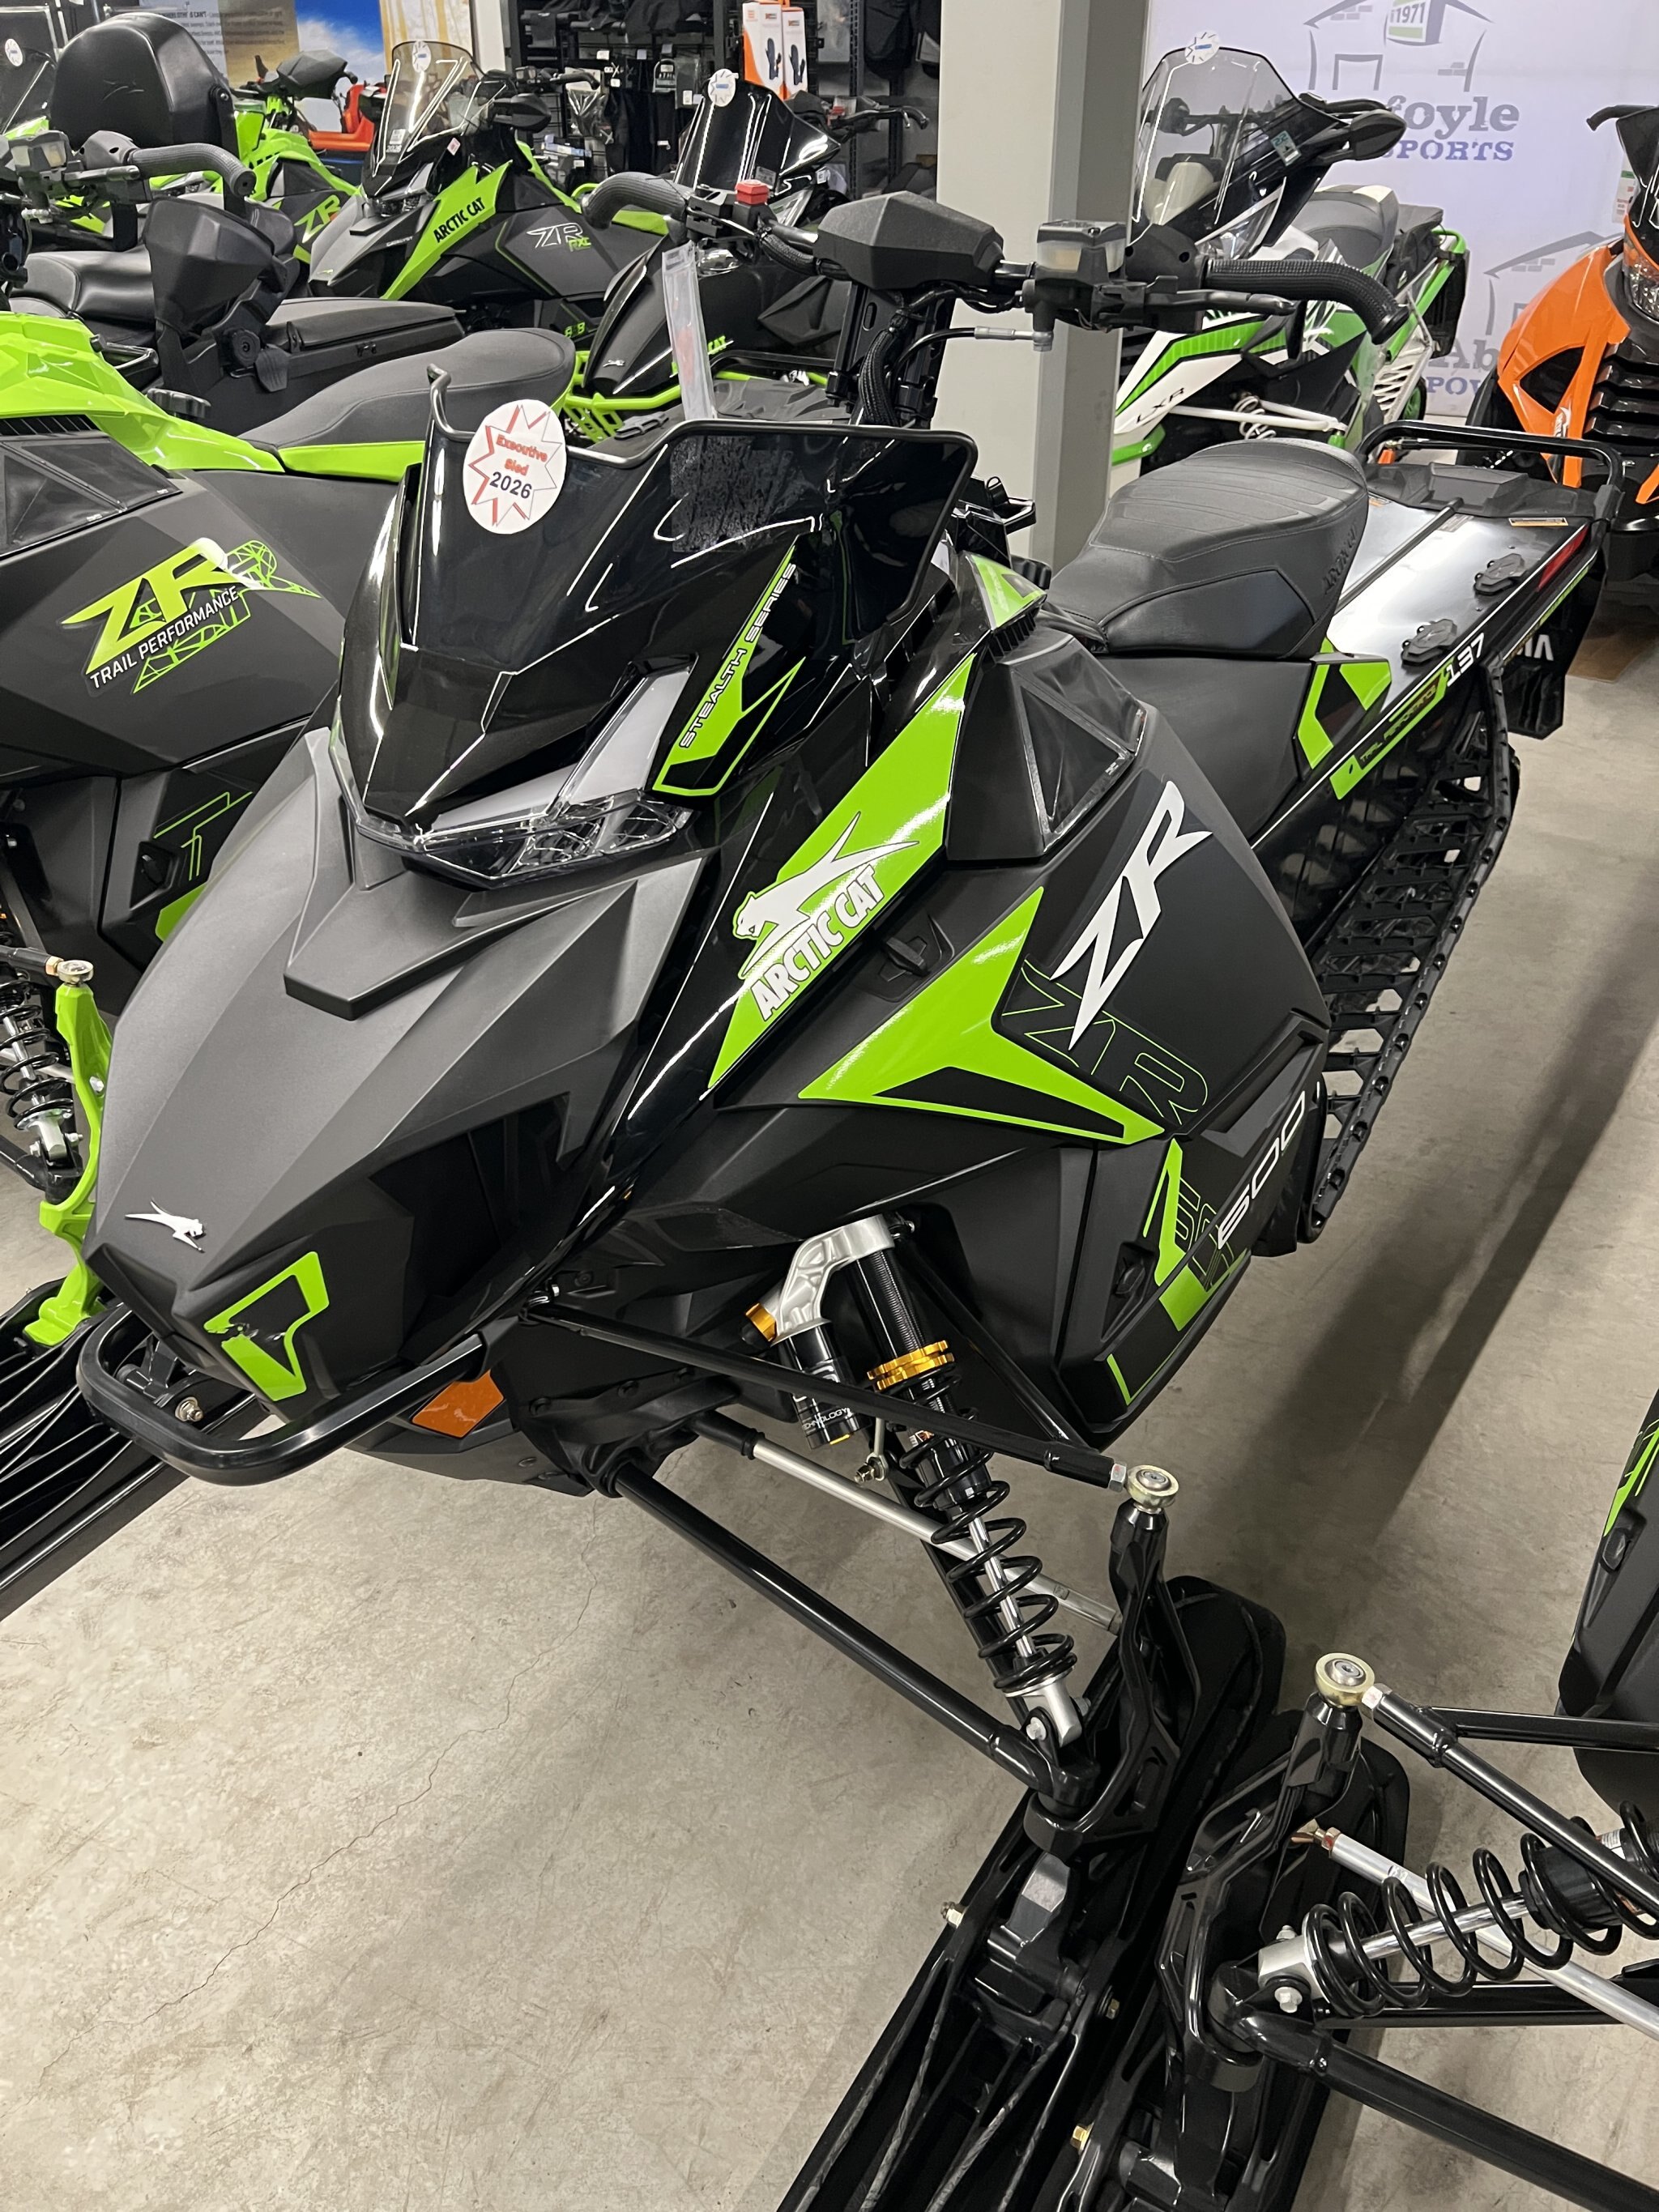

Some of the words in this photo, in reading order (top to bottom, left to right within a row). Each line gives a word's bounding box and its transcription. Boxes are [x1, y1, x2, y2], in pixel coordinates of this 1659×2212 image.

[1387, 95, 1520, 139] foyle
[1382, 139, 1514, 161] PORTS
[433, 212, 467, 243] ARCTIC
[467, 197, 486, 218] CAT
[496, 434, 548, 462] Executive
[504, 458, 529, 476] Sled
[489, 471, 532, 499] 2026
[61, 537, 264, 675] ZR
[90, 653, 137, 688] TRAIL
[139, 586, 239, 660] PERFORMANCE
[680, 649, 747, 748] STEALTH
[744, 562, 796, 642] SERIES
[1446, 632, 1484, 687] 137
[750, 910, 844, 1022] ARCTIC
[834, 863, 885, 928] CAT
[1050, 781, 1212, 1051] ZR
[1218, 1090, 1305, 1250] 600
